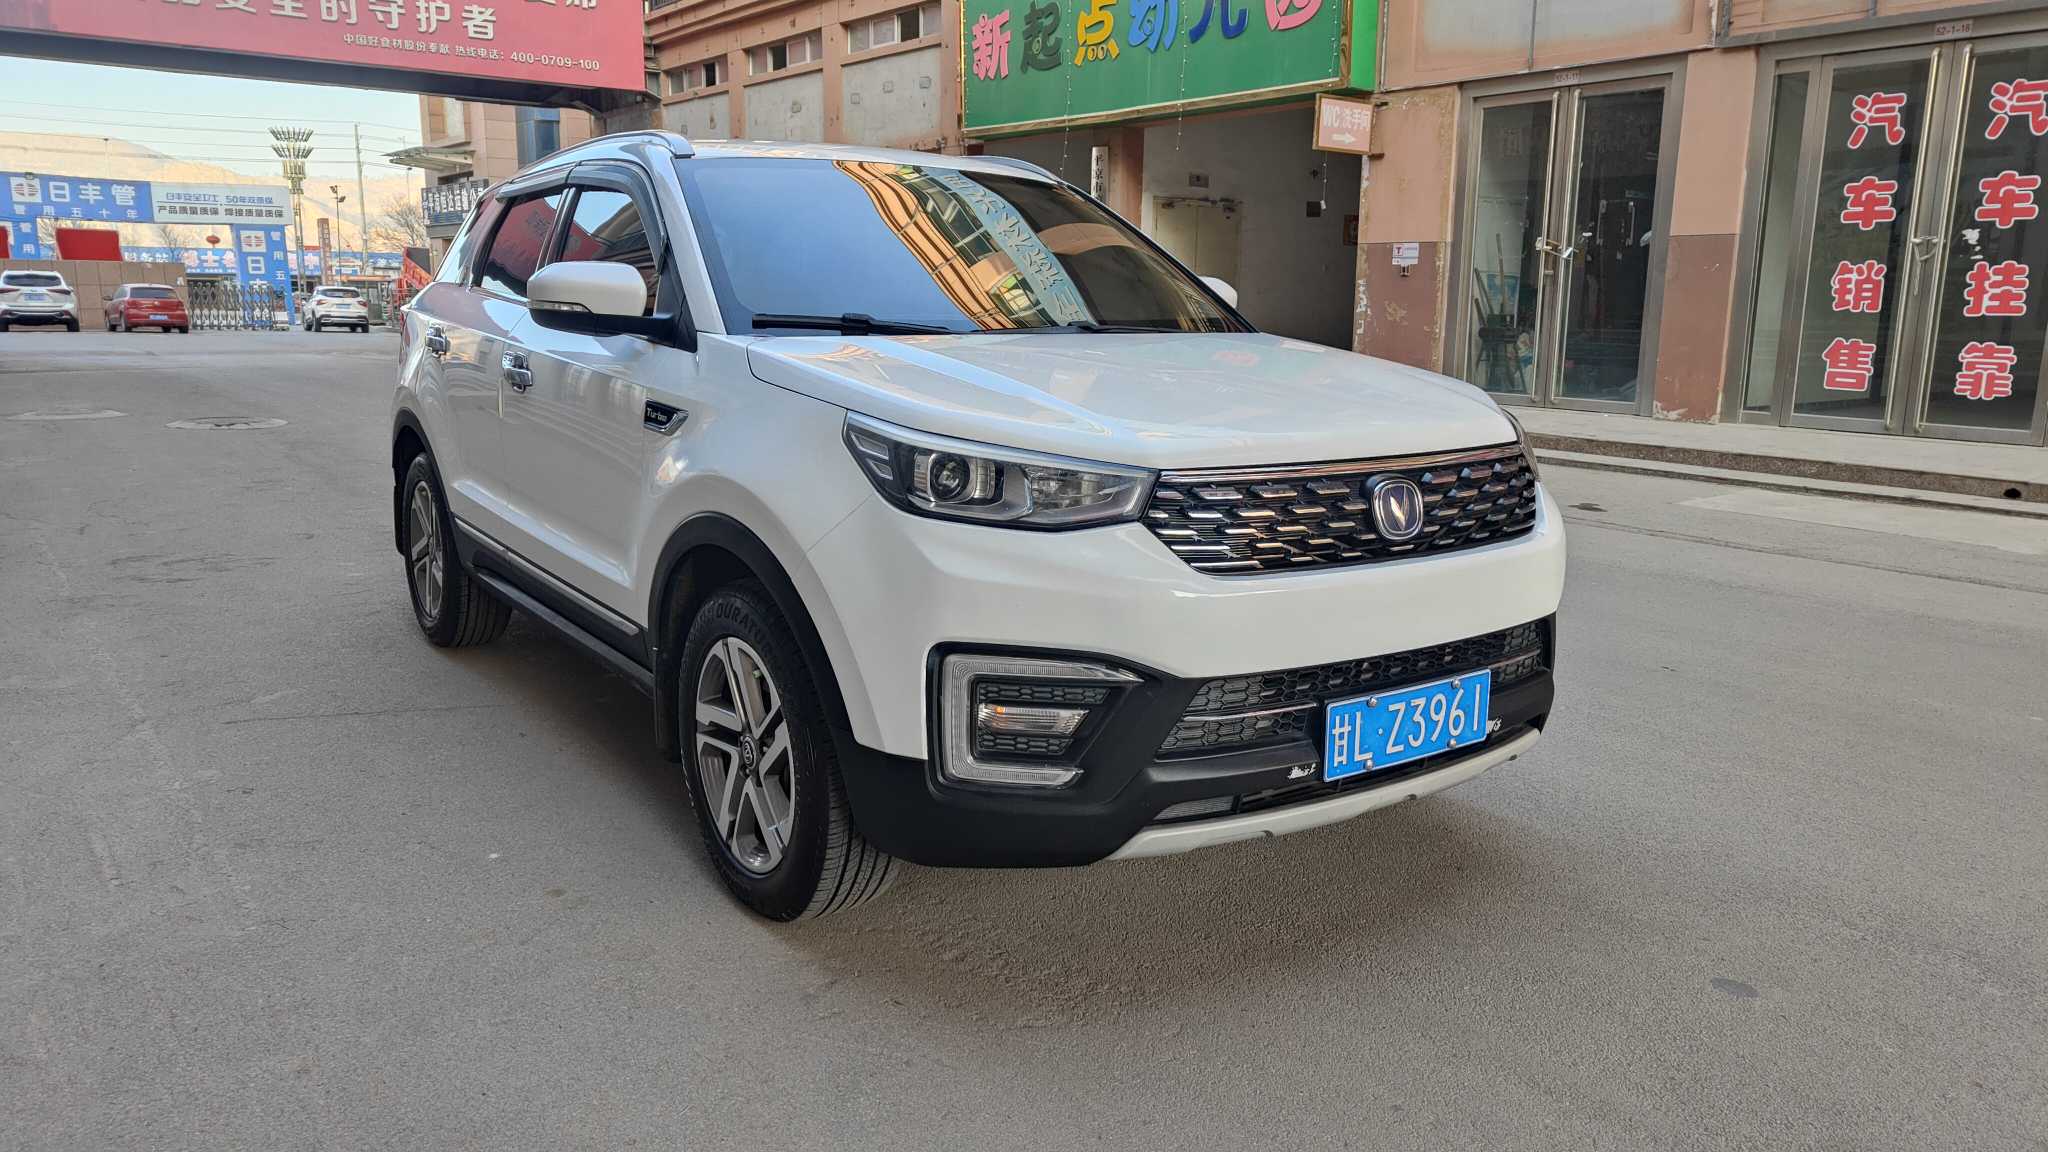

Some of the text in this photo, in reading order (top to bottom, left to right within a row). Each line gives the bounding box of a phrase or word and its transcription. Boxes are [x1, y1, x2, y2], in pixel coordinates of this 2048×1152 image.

[510, 50, 600, 71] 400-0709-100
[48, 181, 136, 206] 日丰管
[1822, 91, 1907, 392] 汽车销售
[1953, 78, 2048, 400] 汽车挂靠
